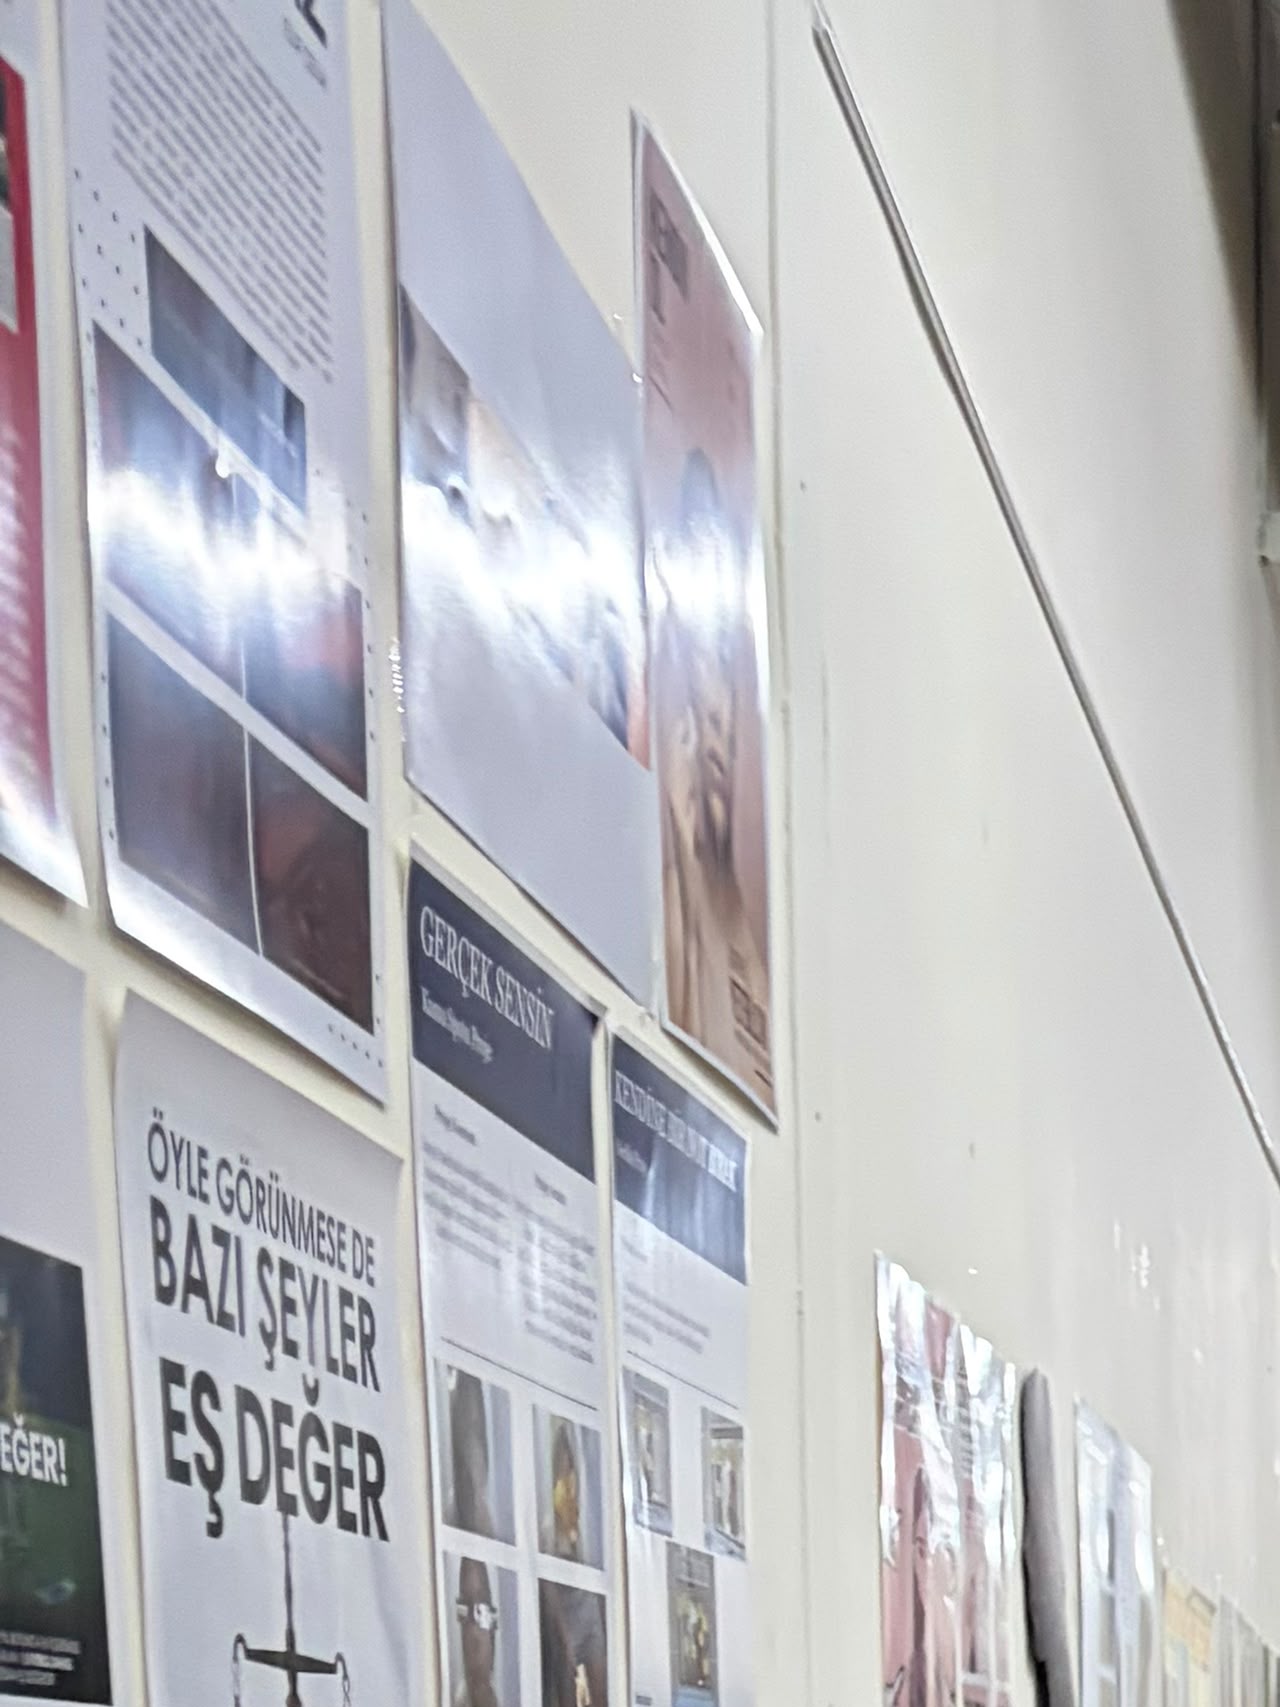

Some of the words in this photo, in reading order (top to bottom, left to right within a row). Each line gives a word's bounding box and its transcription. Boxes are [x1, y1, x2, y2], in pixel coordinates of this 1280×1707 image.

[419, 905, 494, 1007] GERÇEK
[495, 965, 554, 1050] SENSİN
[147, 1106, 210, 1205] ÖYLE
[215, 1154, 347, 1274] GÖRÜNMESE
[352, 1227, 376, 1288] DE
[149, 1194, 246, 1337] BAZI
[256, 1246, 381, 1392] ŞEYLER
[159, 1356, 224, 1539] EŞ
[234, 1373, 390, 1542] DEĞER
